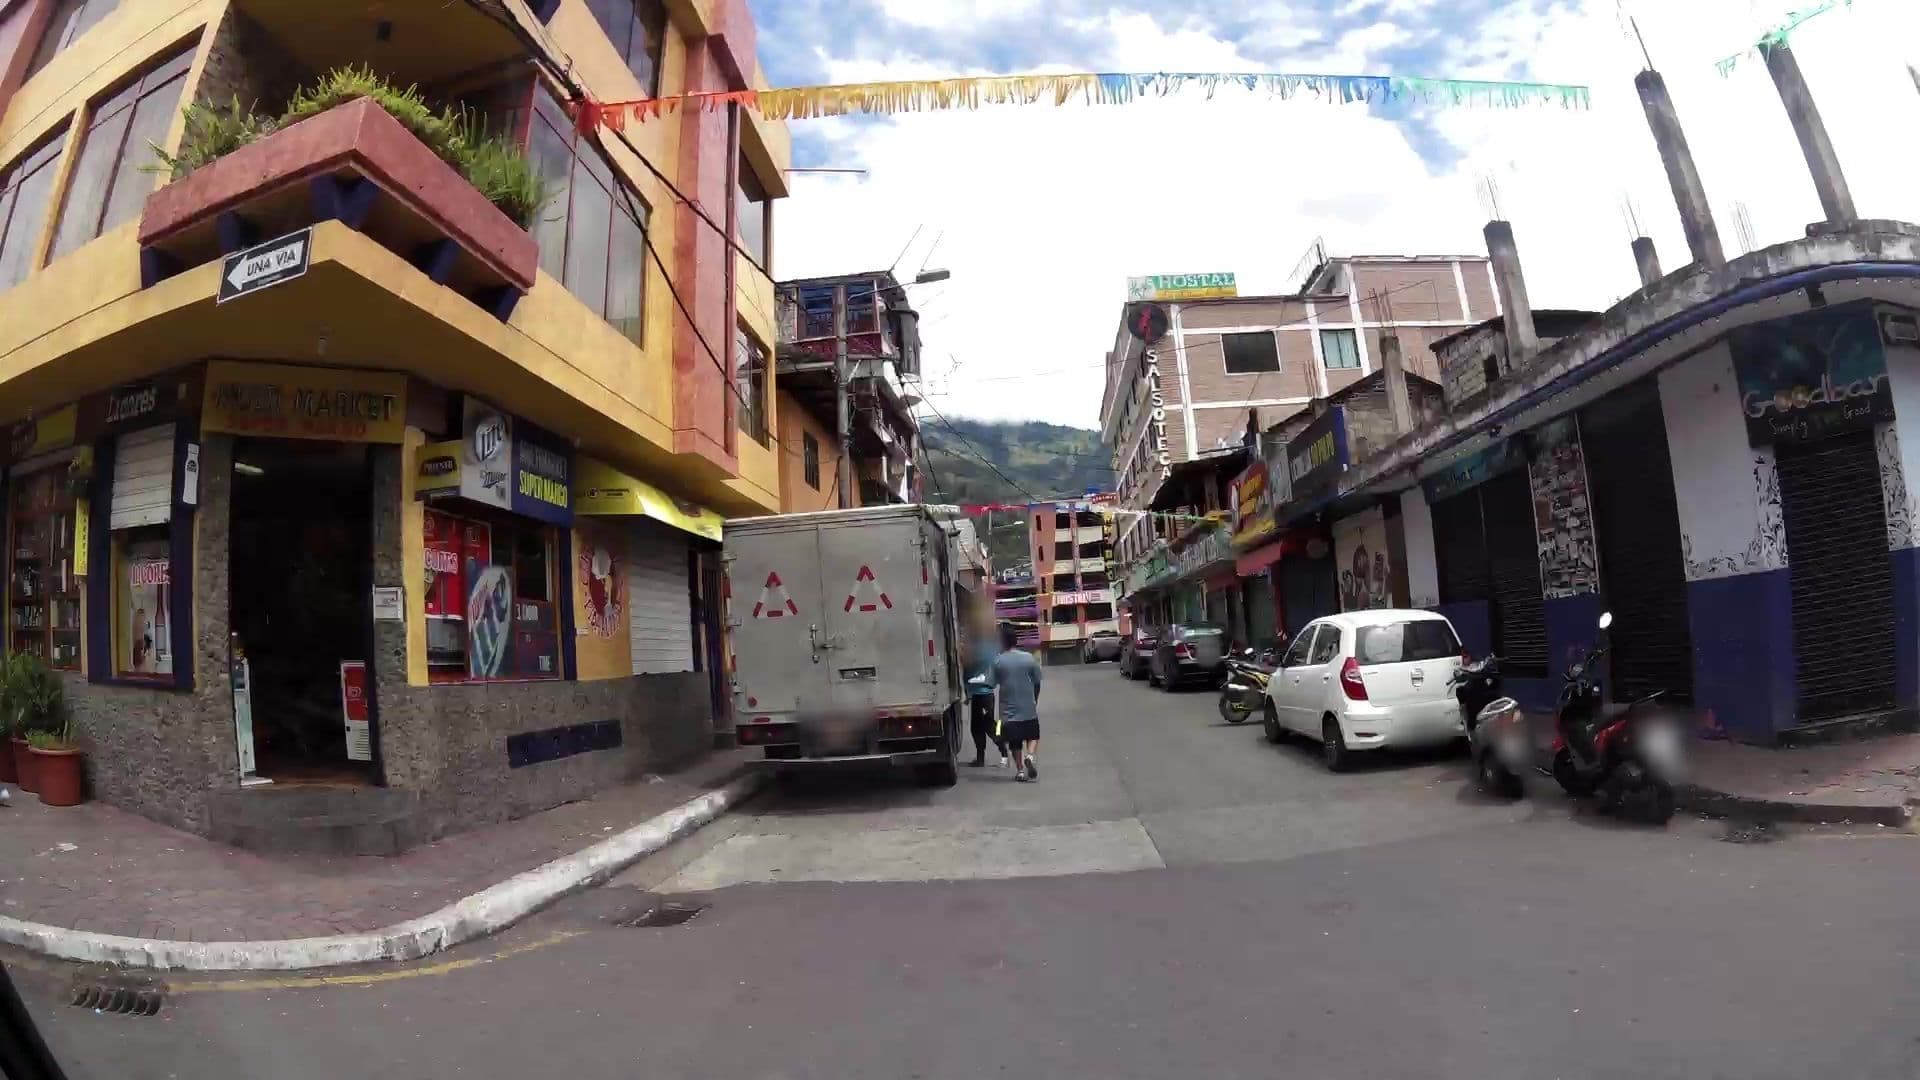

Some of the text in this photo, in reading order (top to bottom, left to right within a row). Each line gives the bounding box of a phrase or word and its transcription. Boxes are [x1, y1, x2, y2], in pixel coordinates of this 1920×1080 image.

[247, 249, 296, 277] UNA VIA
[1158, 272, 1234, 289] HOSTAL
[295, 387, 398, 421] MARKET
[1145, 348, 1172, 481] SALSOTECA
[1767, 416, 1809, 440] Simply
[519, 469, 544, 501] SUPER
